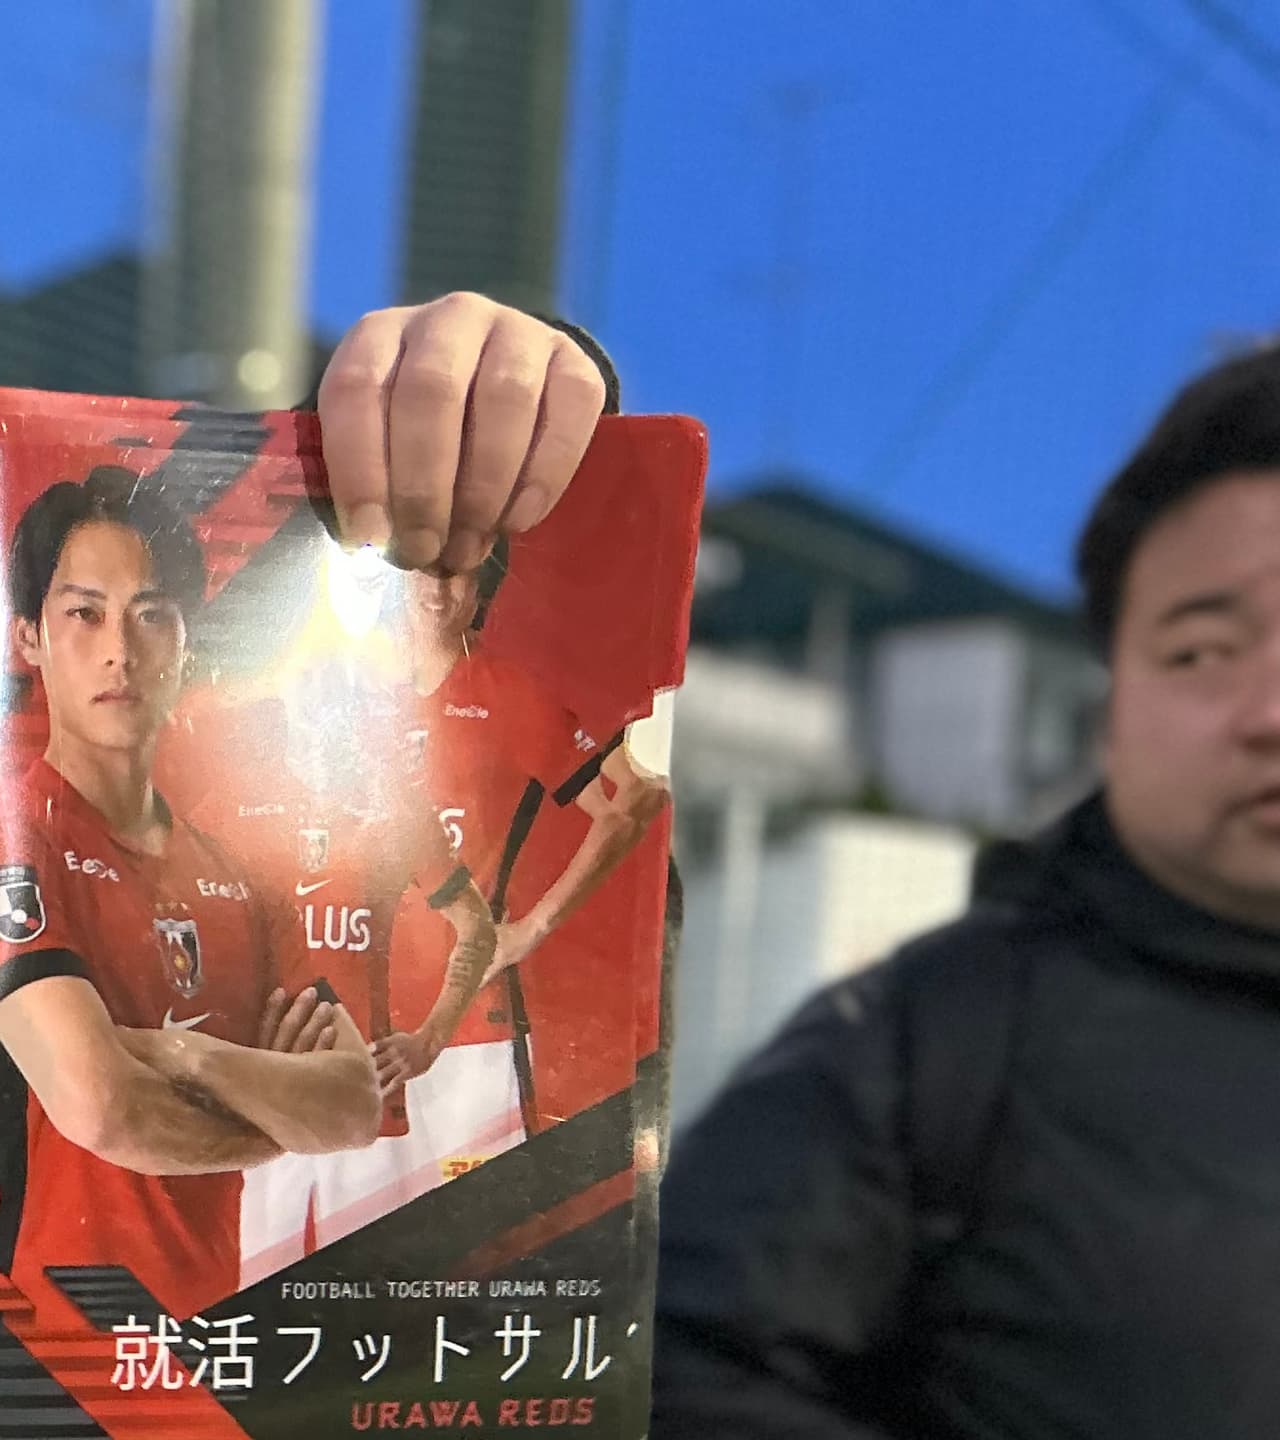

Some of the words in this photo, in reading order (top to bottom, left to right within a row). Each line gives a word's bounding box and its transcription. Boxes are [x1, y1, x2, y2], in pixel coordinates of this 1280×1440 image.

[296, 903, 372, 951] LUS
[281, 1281, 376, 1300] FOOTBALL
[387, 1280, 480, 1299] TOGETHER
[489, 1280, 547, 1298] URAWA
[555, 1279, 602, 1297] REDS
[111, 1313, 639, 1391] 就活フットサル
[351, 1400, 483, 1431] URAWA
[498, 1397, 595, 1427] REDS
